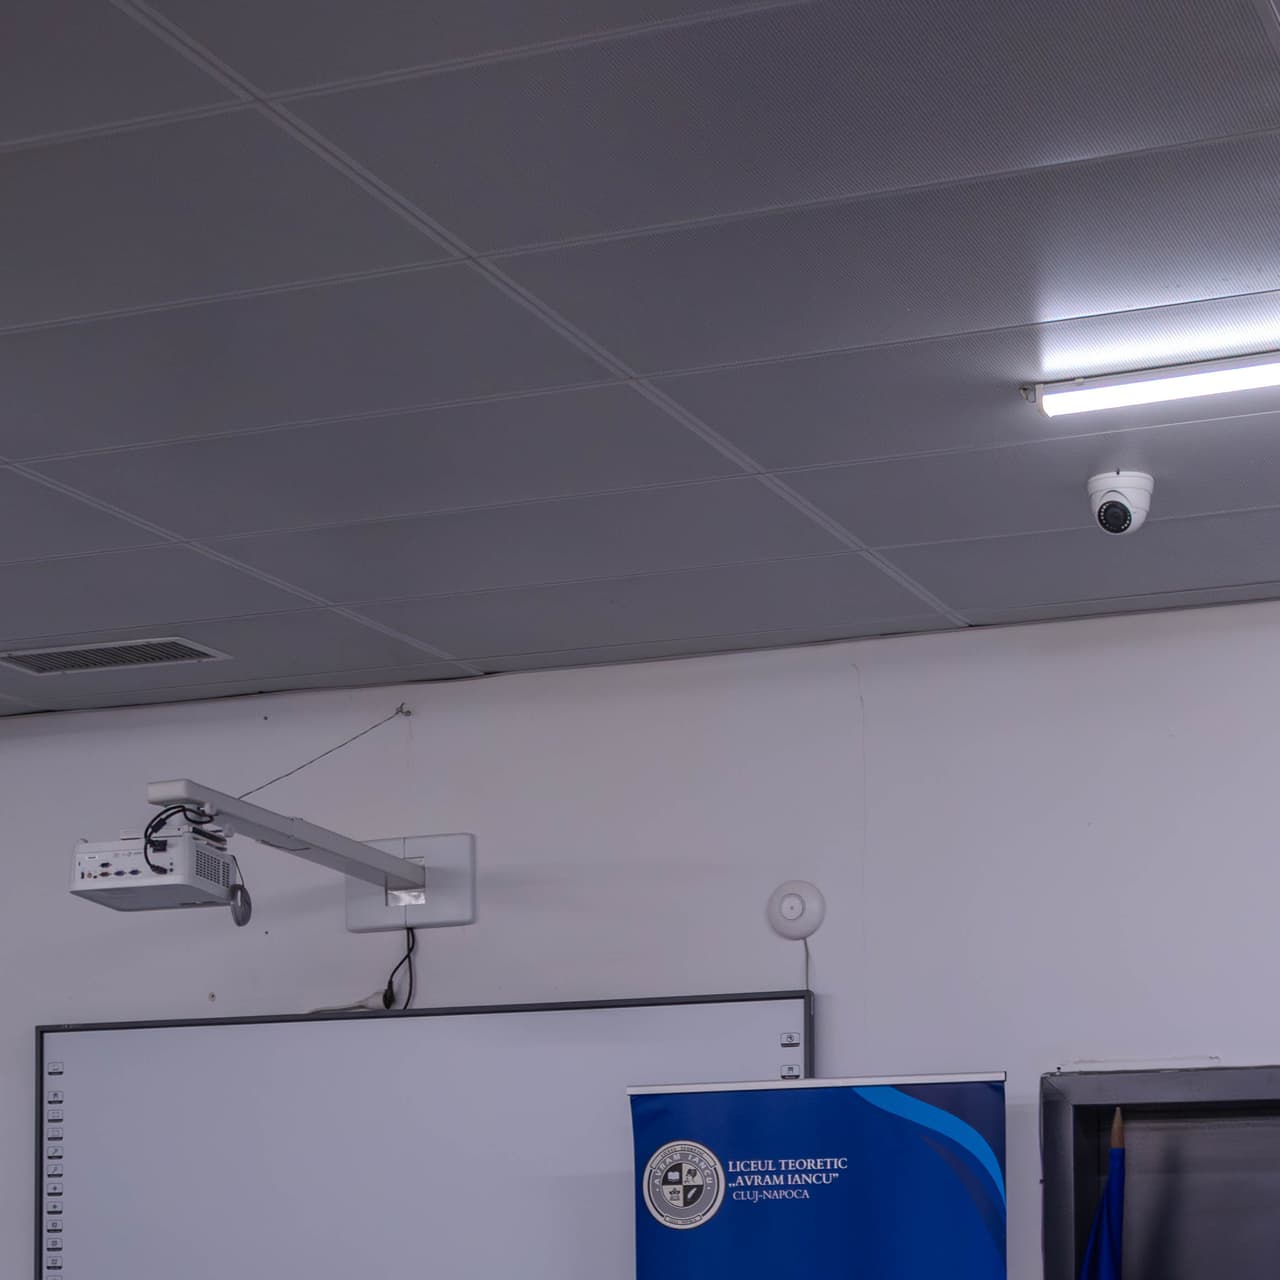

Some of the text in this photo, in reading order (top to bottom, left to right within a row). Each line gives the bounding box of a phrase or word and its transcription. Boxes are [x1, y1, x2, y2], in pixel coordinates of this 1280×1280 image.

[728, 1157, 848, 1172] LICEUL TEORETIC
[733, 1188, 810, 1203] CLUJ-NAPOCA
